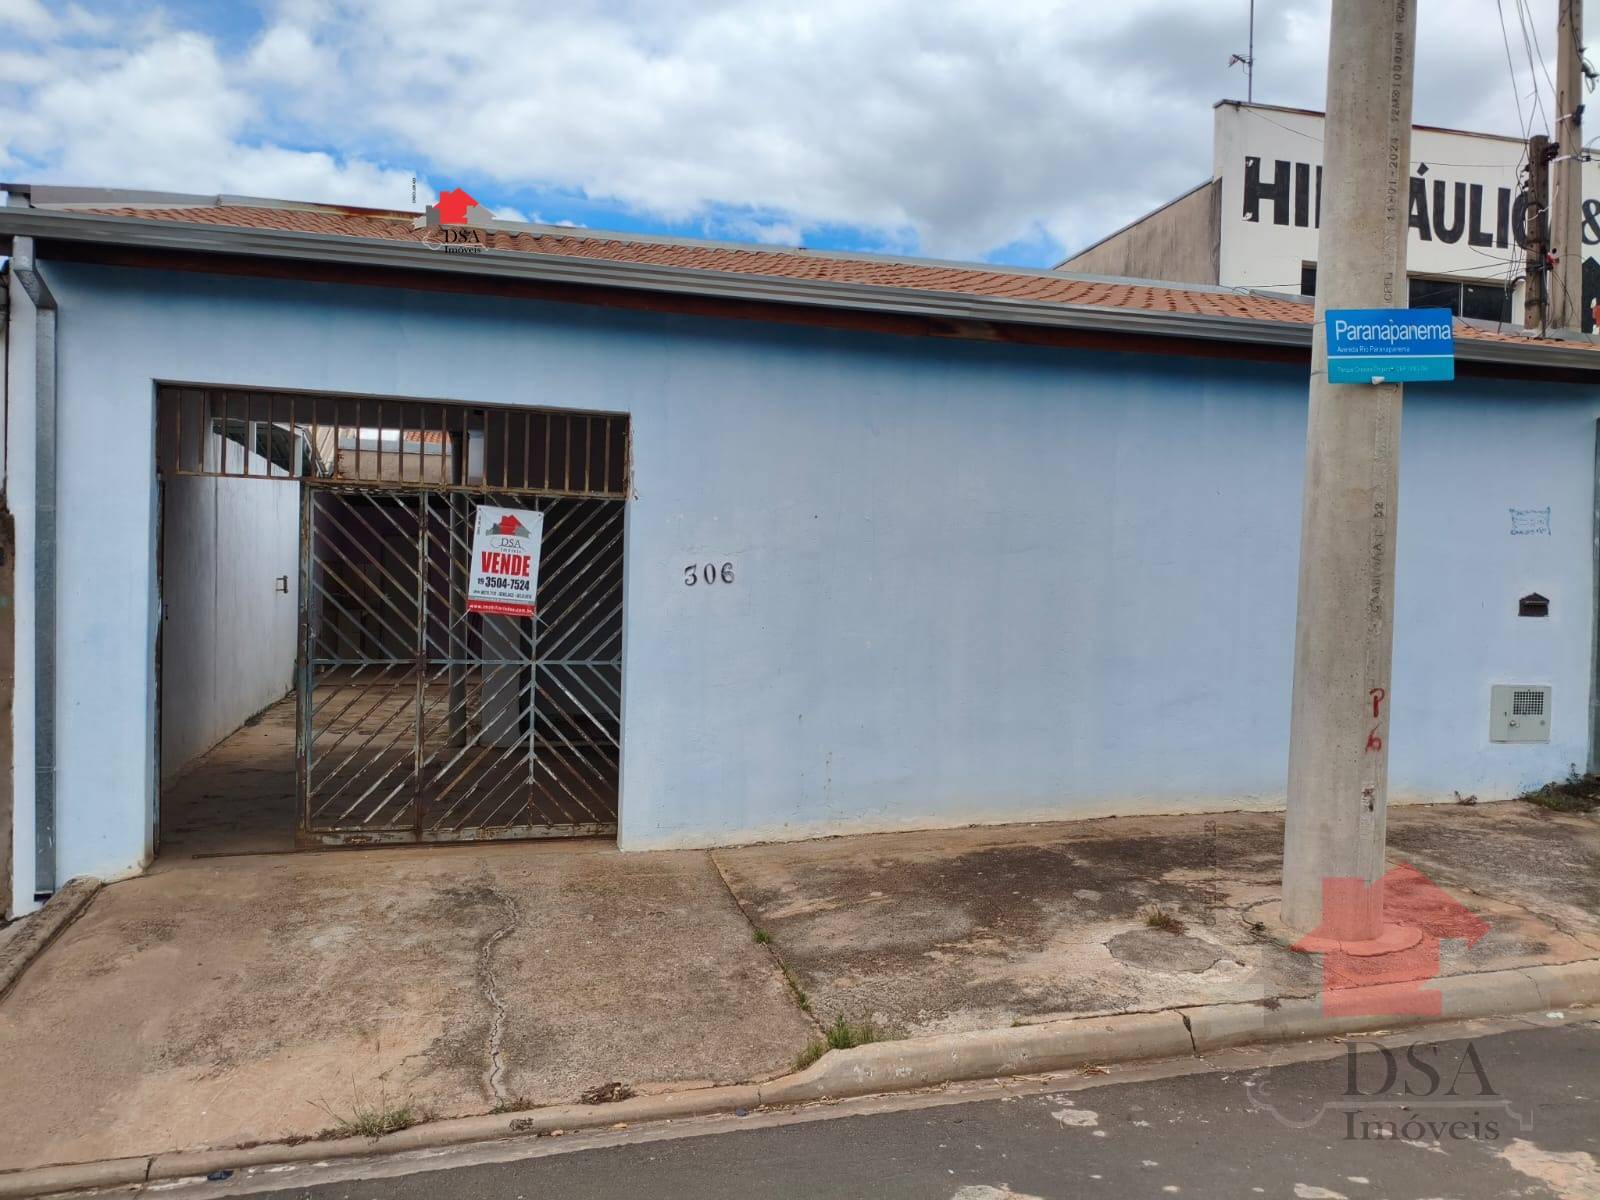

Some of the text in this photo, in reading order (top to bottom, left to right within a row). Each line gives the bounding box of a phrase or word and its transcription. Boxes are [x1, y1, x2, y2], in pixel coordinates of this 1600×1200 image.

[1243, 155, 1527, 251] HIÁULI
[1582, 199, 1600, 245] &
[1335, 319, 1451, 345] Paranapanema
[500, 537, 521, 549] DSA
[481, 551, 531, 577] VENDE
[685, 562, 735, 587] 306
[485, 576, 530, 592] 3504-7524
